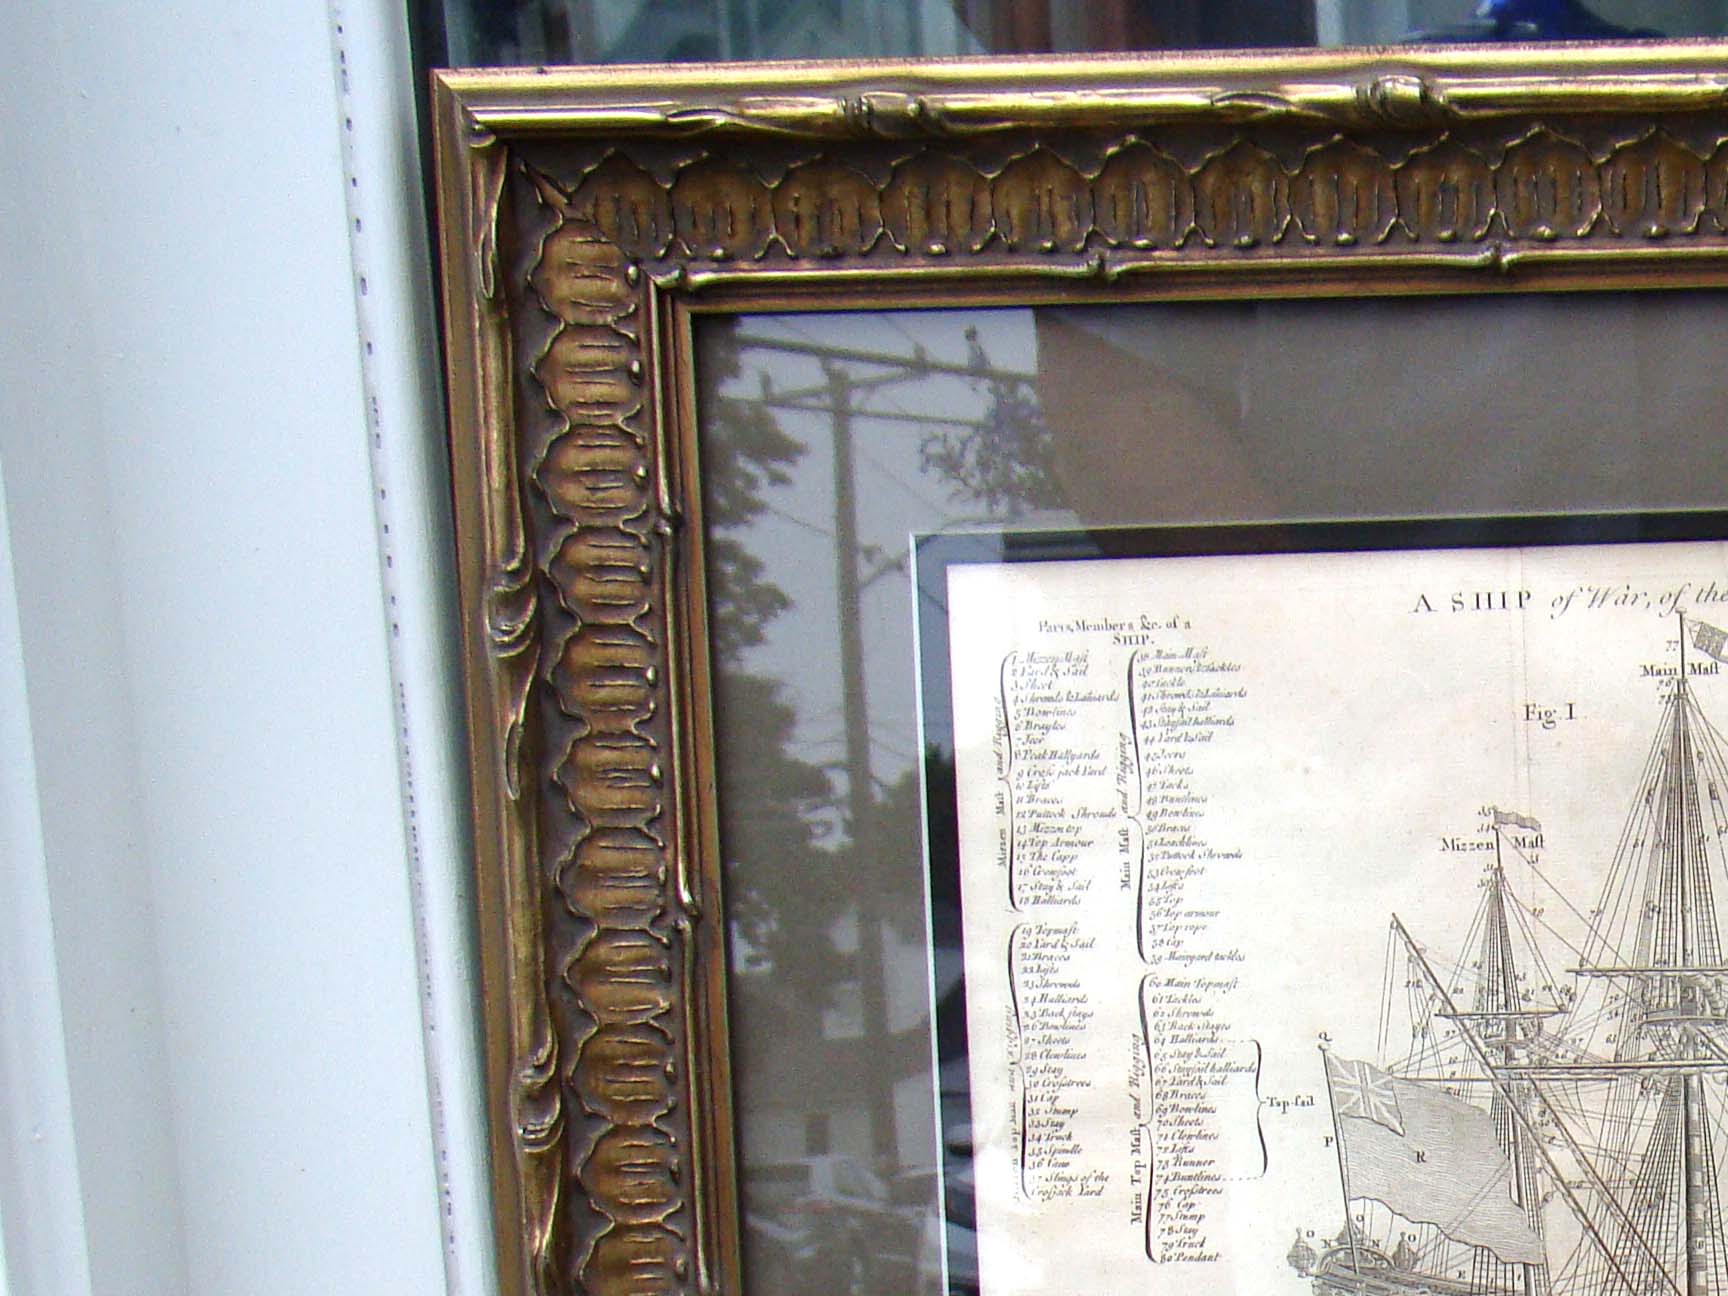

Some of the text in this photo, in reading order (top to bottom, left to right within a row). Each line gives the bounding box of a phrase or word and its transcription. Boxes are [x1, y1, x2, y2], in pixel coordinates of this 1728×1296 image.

[1414, 594, 1436, 613] A
[1452, 591, 1531, 612] SHIP
[1550, 587, 1583, 620] of
[1659, 583, 1691, 618] of
[1640, 663, 1677, 678] Main
